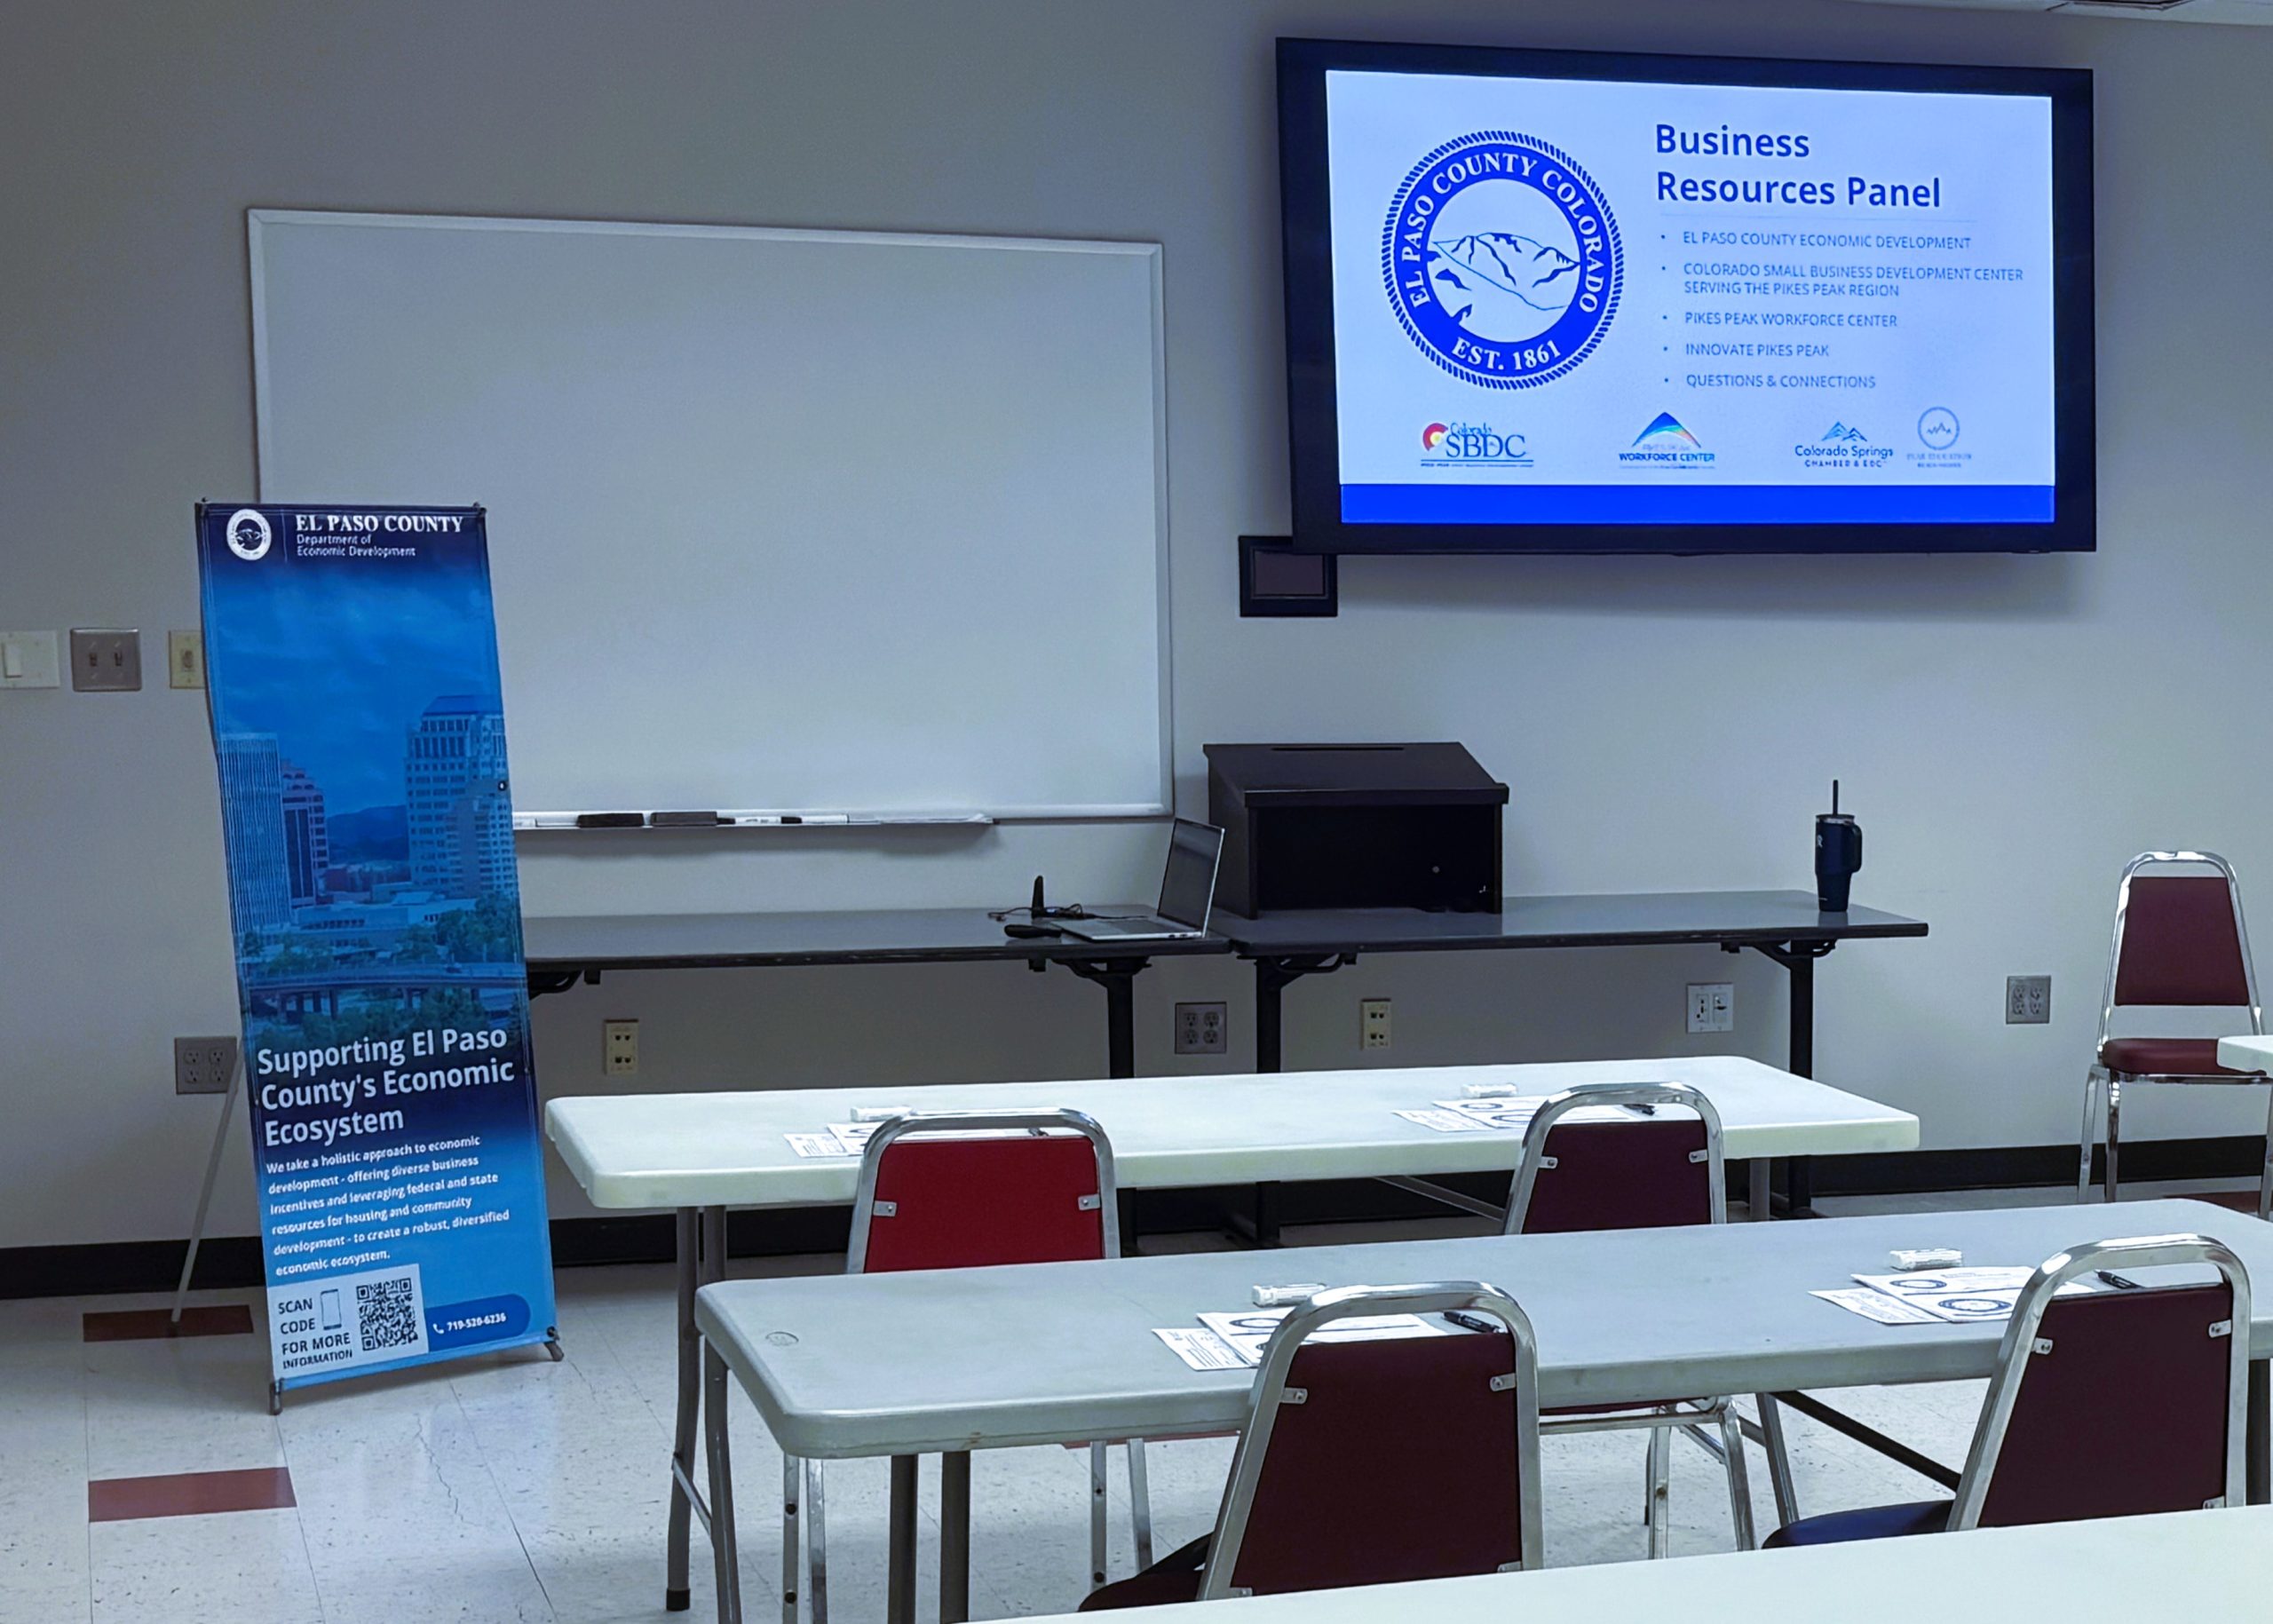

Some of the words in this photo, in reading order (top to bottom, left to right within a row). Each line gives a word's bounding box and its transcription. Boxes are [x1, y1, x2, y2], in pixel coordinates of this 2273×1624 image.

[1656, 124, 1810, 157] Business
[1433, 152, 1538, 194] COUNTY
[1658, 171, 1835, 204] Resources
[1848, 178, 1940, 207] Panel
[1401, 195, 1435, 262] PASO
[1542, 169, 1604, 313] COLORADO
[1683, 232, 1699, 243] EL
[1702, 233, 1737, 245] PASO
[1740, 234, 1797, 246] COUNTY
[1801, 234, 1873, 248] ECONOMIC
[1876, 235, 1971, 250] DEVELOPMENT
[1684, 264, 1760, 277] COLORADO
[1763, 265, 1806, 277] SMALL
[1811, 265, 1873, 279] BUSINESS
[1876, 267, 1971, 280] DEVELOPMENT
[1975, 268, 2023, 281] CENTER
[1406, 271, 1431, 308] EL
[1684, 281, 1741, 295] SERVING
[1744, 282, 1770, 295] THE
[1773, 283, 1810, 296] PIKES
[1813, 283, 1846, 296] PEAK
[1849, 284, 1899, 297] REGION
[1685, 313, 1721, 325] PIKES
[1724, 313, 1758, 326] PEAK
[1762, 313, 1844, 326] WORKFORCE
[1848, 315, 1897, 328] CENTER
[1452, 337, 1505, 370] EST.
[1513, 340, 1561, 369] 1861
[1686, 344, 1753, 356] INNOVATE
[1757, 344, 1794, 356] PIKES
[1797, 345, 1829, 356] PEAK
[1686, 374, 1763, 388] QUESTIONS
[1767, 375, 1777, 388] &
[1780, 375, 1875, 388] CONNECTIONS
[1446, 434, 1526, 457] SBDC
[1794, 445, 1848, 456] Colorado
[1852, 446, 1893, 460] Springs
[296, 515, 322, 531] EL
[329, 515, 378, 532] PASO
[384, 515, 463, 533] COUNTY
[297, 534, 358, 545] Department
[361, 535, 371, 544] of
[297, 546, 345, 556] Economic
[349, 546, 416, 558] Development
[257, 1036, 405, 1078] Supporting
[413, 1032, 434, 1058] El
[442, 1029, 507, 1054] Paso
[261, 1075, 376, 1110] County's
[384, 1058, 514, 1096] Economic
[265, 1109, 404, 1146] Ecosystem
[266, 1163, 284, 1175] We
[287, 1161, 310, 1172] take
[313, 1159, 318, 1168] a
[321, 1152, 360, 1166] holistic
[363, 1145, 412, 1163] approach
[415, 1144, 426, 1154] to
[429, 1136, 480, 1152] economic
[268, 1176, 339, 1195] development
[347, 1168, 390, 1184] offering
[392, 1163, 431, 1177] diverse
[432, 1157, 479, 1171] business
[270, 1199, 324, 1215] incentives
[327, 1193, 347, 1207] and
[350, 1187, 405, 1205] leveraging
[407, 1180, 445, 1194] federal
[447, 1177, 468, 1189] and
[470, 1174, 498, 1184] state
[272, 1220, 325, 1235] resources
[328, 1215, 343, 1227] for
[345, 1209, 388, 1224] housing
[390, 1205, 409, 1217] and
[412, 1198, 471, 1215] community
[273, 1237, 345, 1257] development
[353, 1233, 366, 1243] to
[368, 1227, 400, 1240] create
[412, 1220, 450, 1234] robust,
[453, 1209, 510, 1227] diversified
[275, 1260, 329, 1277] economic
[331, 1251, 390, 1269] ecosystem.
[278, 1299, 313, 1314] SCAN
[281, 1319, 315, 1335] CODE
[282, 1341, 308, 1355] FOR
[313, 1333, 351, 1349] MORE
[283, 1350, 352, 1369] INFORMATION
